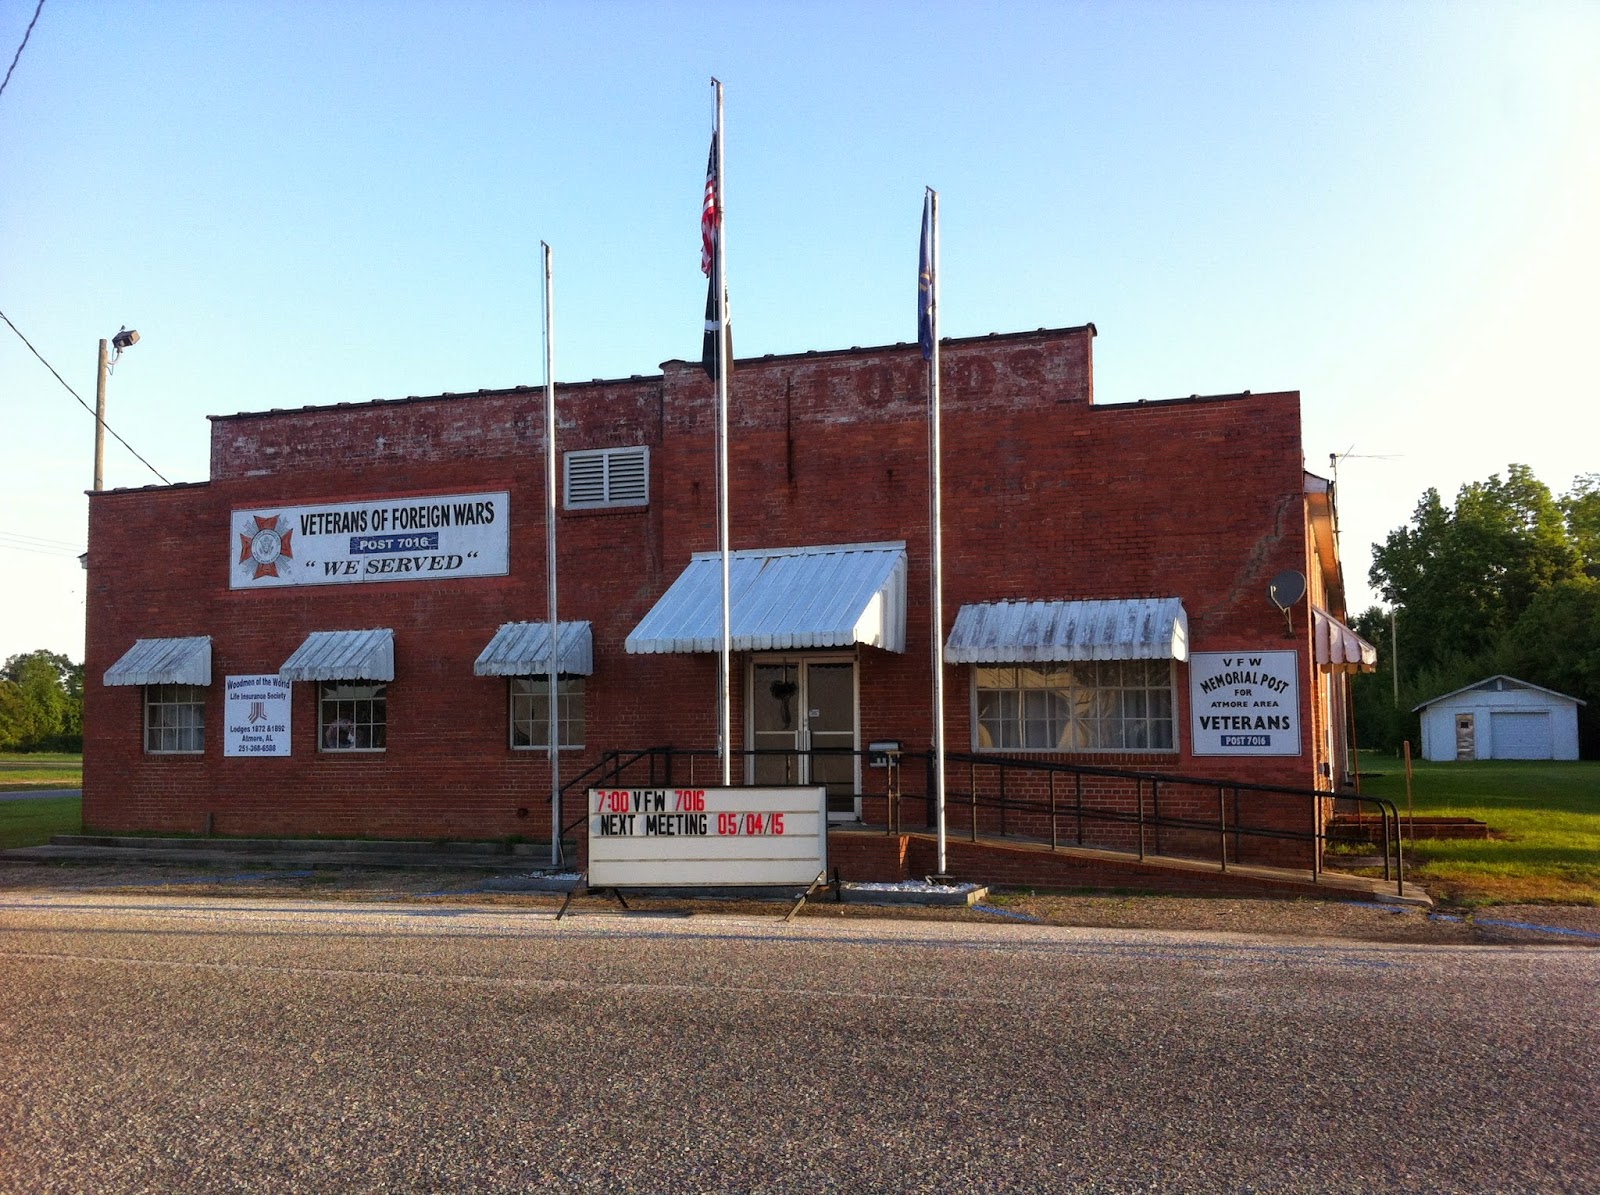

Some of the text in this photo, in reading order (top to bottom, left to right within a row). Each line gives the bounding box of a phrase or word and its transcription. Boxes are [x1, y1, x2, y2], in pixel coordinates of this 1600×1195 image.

[301, 501, 495, 535] VETERANS OF FOREIGN WARS
[359, 536, 429, 550] POST 7016
[227, 677, 290, 690] Woodmen of the World
[1200, 671, 1289, 694] MEMORIAL POST
[240, 692, 266, 700] Insurance
[267, 692, 286, 700] Society
[230, 725, 250, 734] Lodges
[1200, 716, 1290, 730] VETERANS
[1225, 736, 1266, 745] POST 7016
[598, 790, 705, 812] 7:00 VFW 7016
[601, 813, 784, 836] NEXT MEETING 05/04/15
